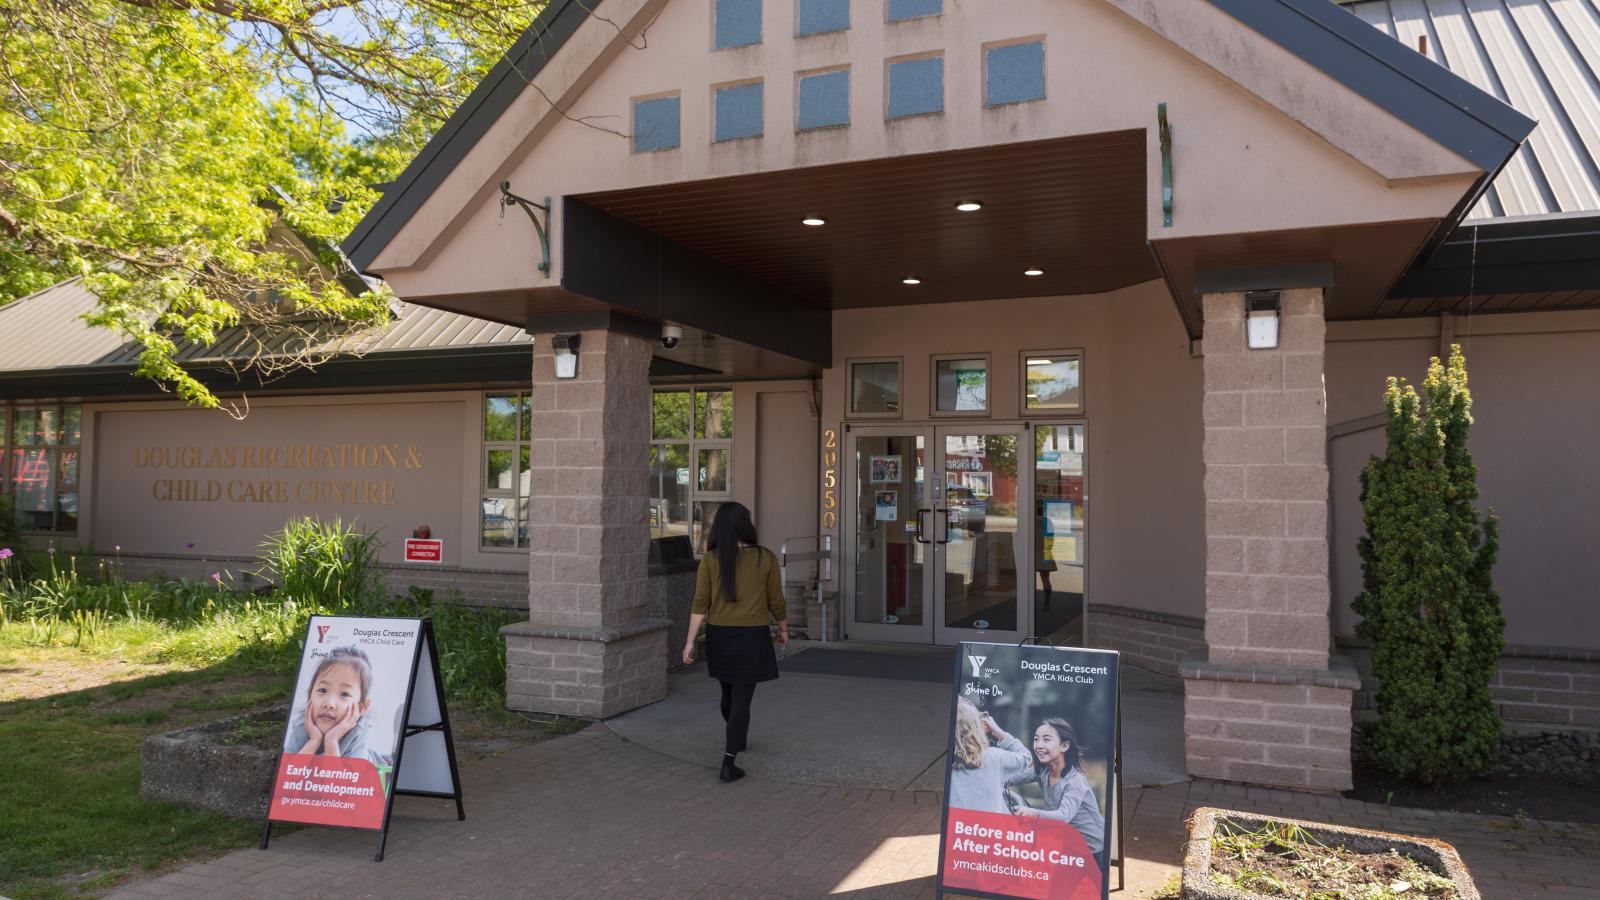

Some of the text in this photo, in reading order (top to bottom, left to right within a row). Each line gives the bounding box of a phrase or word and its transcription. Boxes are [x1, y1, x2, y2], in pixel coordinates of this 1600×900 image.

[134, 442, 423, 469] DOUGLAS RECREATION &
[824, 429, 836, 530] 20550
[152, 479, 398, 505] CHILD CARE CENTRE
[353, 628, 414, 638] Douglas Crescent
[1021, 660, 1108, 675] Douglas Crescent
[1033, 672, 1094, 684] YMCA Kids Club
[965, 682, 1003, 697] Shine On
[286, 764, 360, 782] Early Learning
[283, 780, 374, 796] and Development
[281, 796, 355, 810] gv.ymca.ca/childcare
[955, 821, 1034, 844] Before and
[952, 838, 1085, 867] After School Care
[952, 858, 1049, 881] ymcakidsclubs.ca
